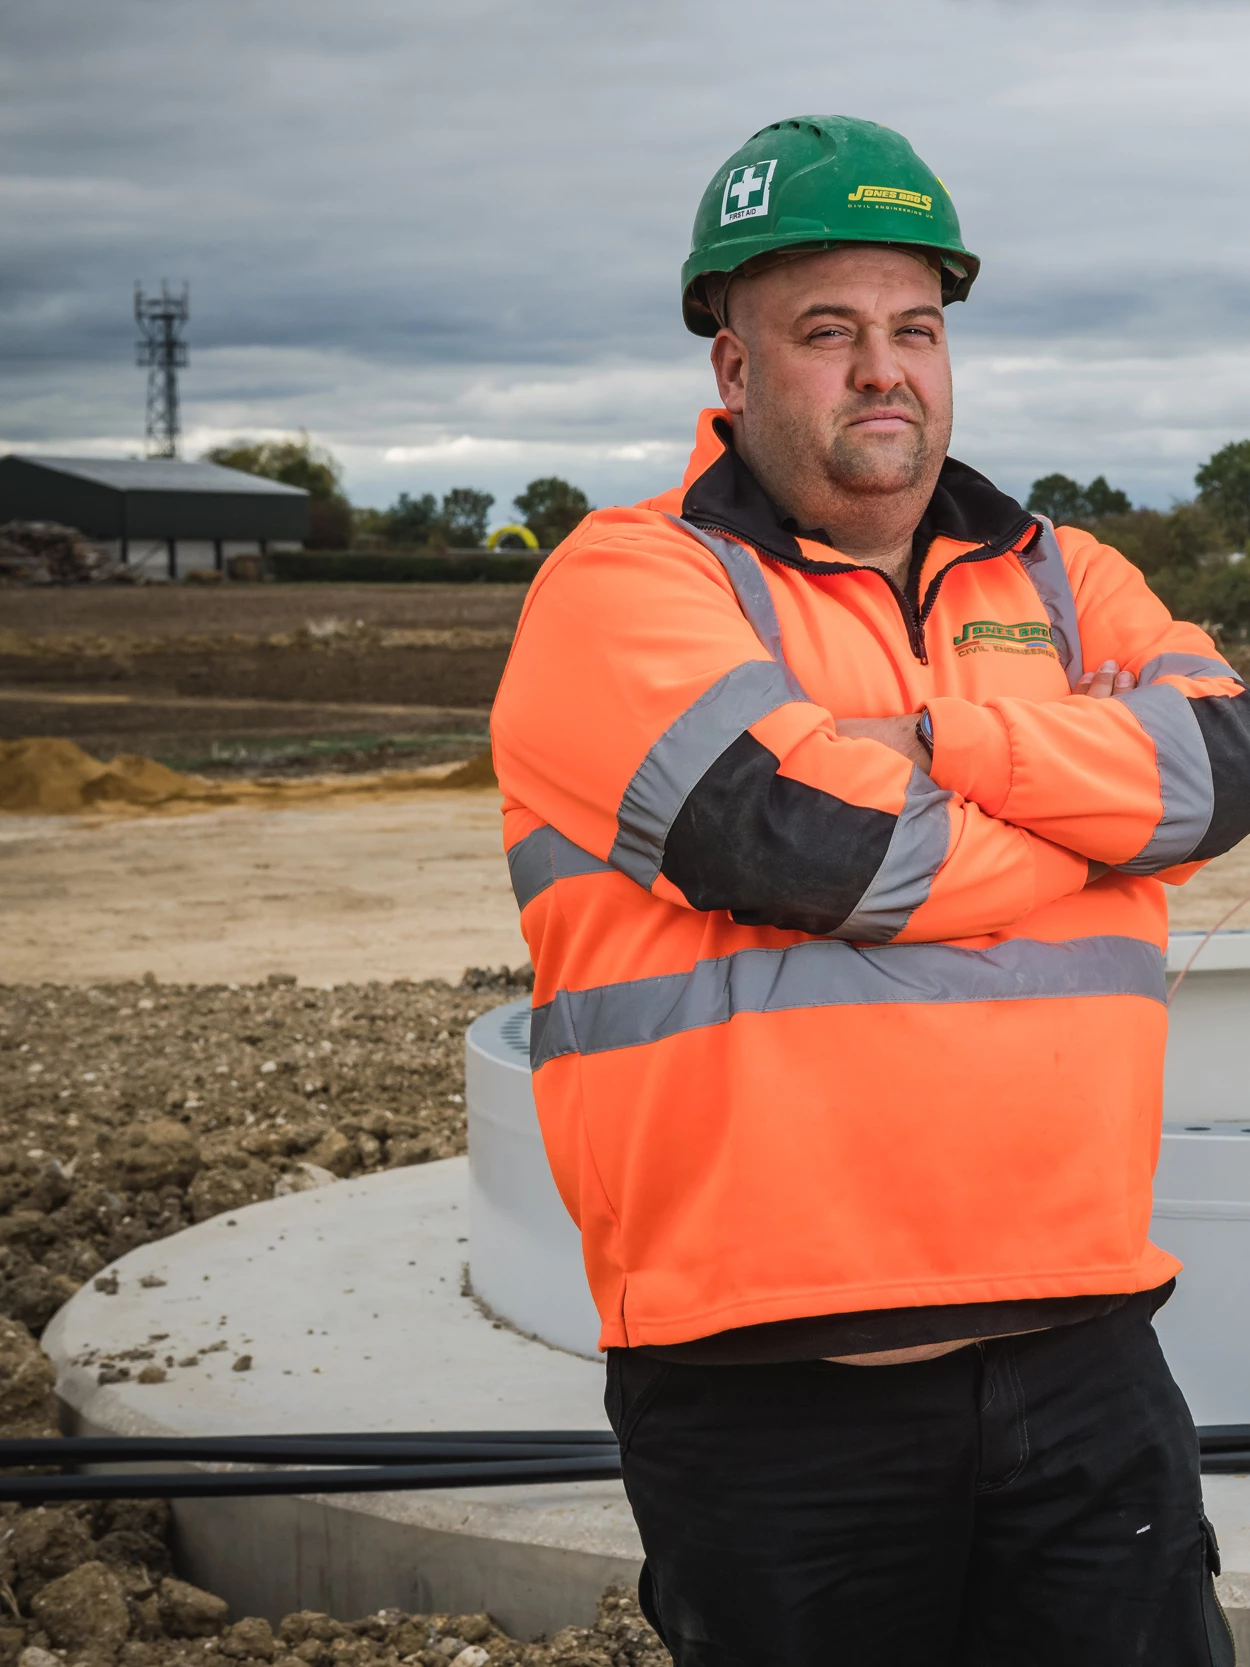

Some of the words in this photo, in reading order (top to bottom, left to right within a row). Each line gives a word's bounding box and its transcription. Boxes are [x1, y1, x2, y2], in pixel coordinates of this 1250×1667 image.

[848, 185, 897, 201] JONES
[729, 211, 745, 220] FIRST
[746, 208, 756, 216] AID
[875, 204, 922, 215] ENGINEERING
[953, 621, 1016, 646] JONES
[958, 645, 989, 658] CIVIL
